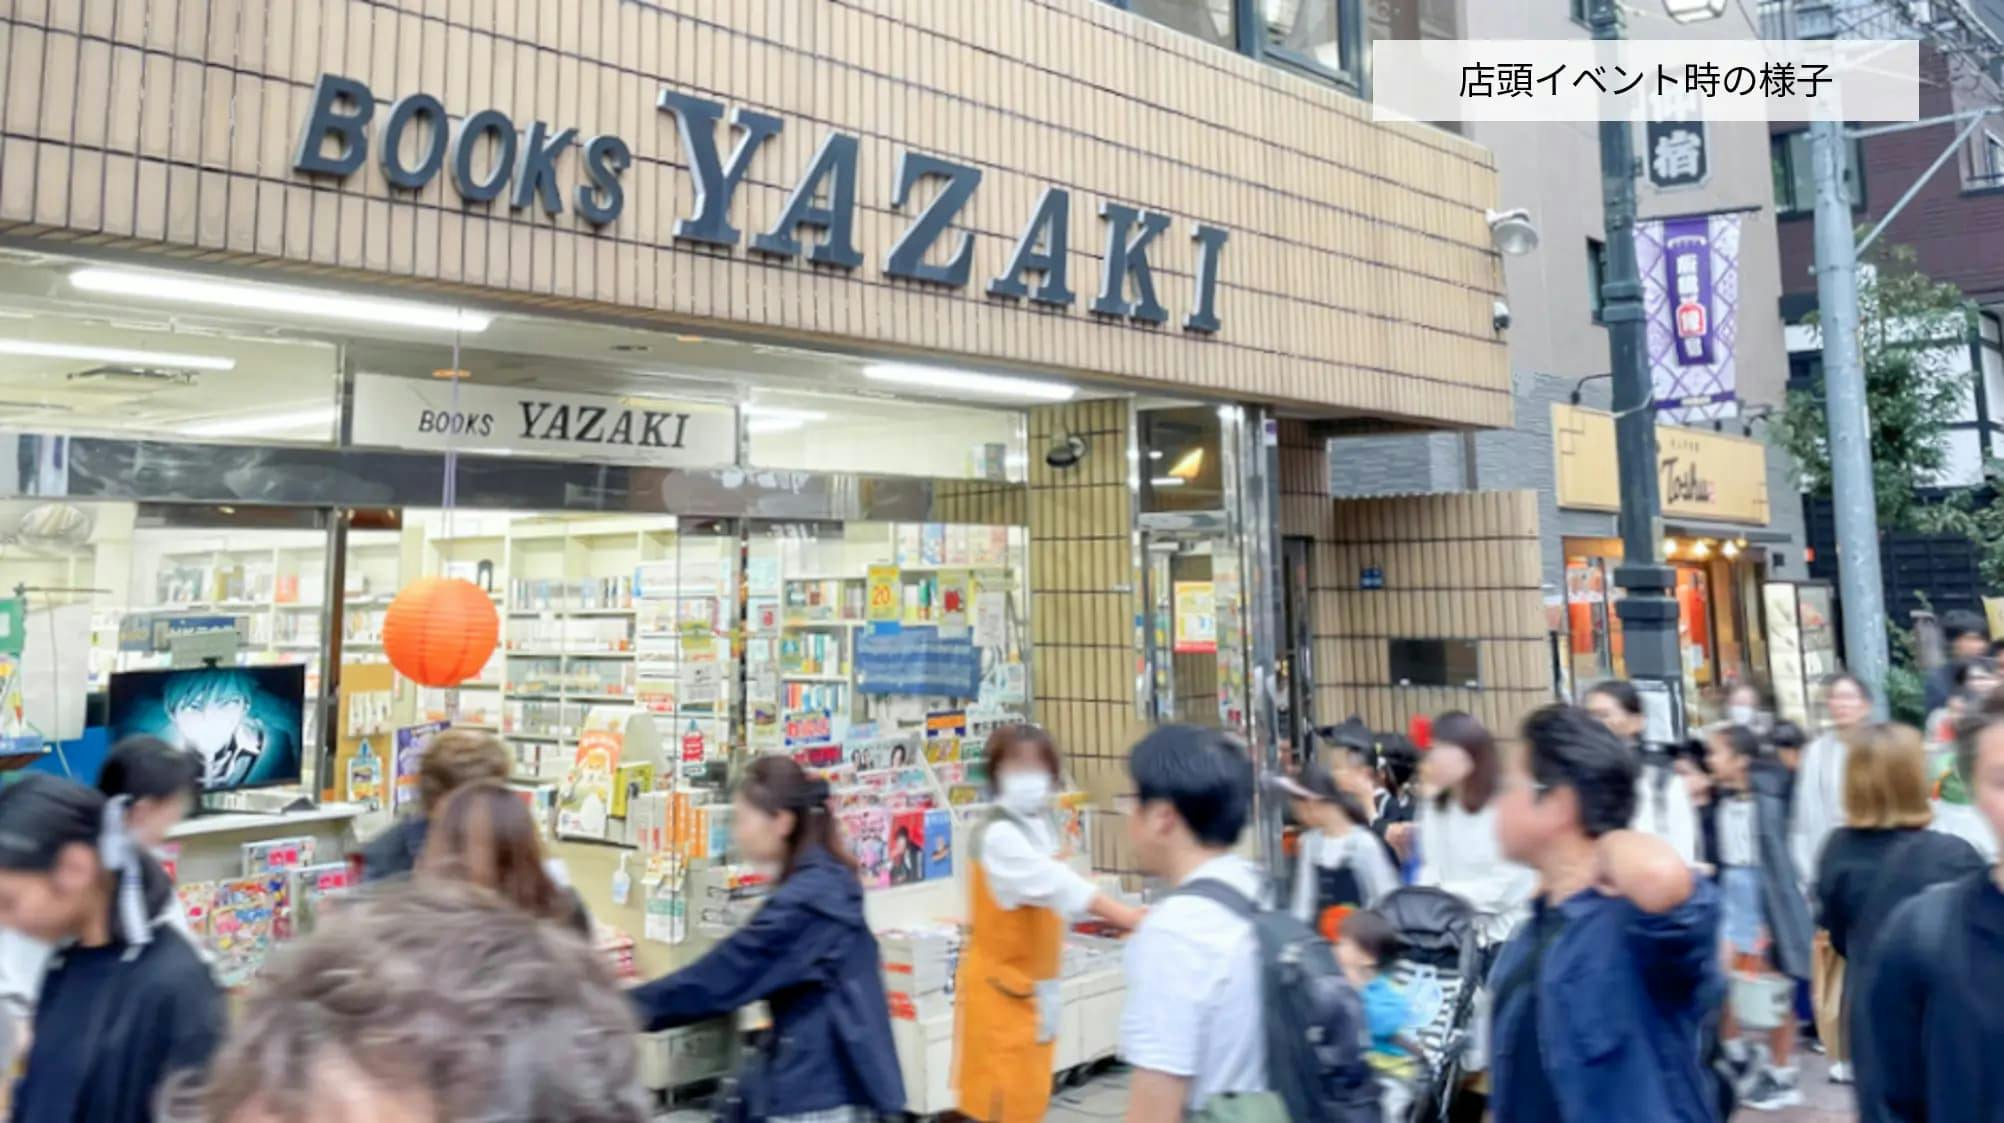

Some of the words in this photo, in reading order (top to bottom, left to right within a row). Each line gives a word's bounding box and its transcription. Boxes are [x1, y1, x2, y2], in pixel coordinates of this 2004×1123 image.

[294, 73, 631, 227] BOOKS
[656, 89, 1228, 334] YAZAKI
[418, 409, 494, 437] BOOKS
[518, 401, 690, 448] YAZAKI
